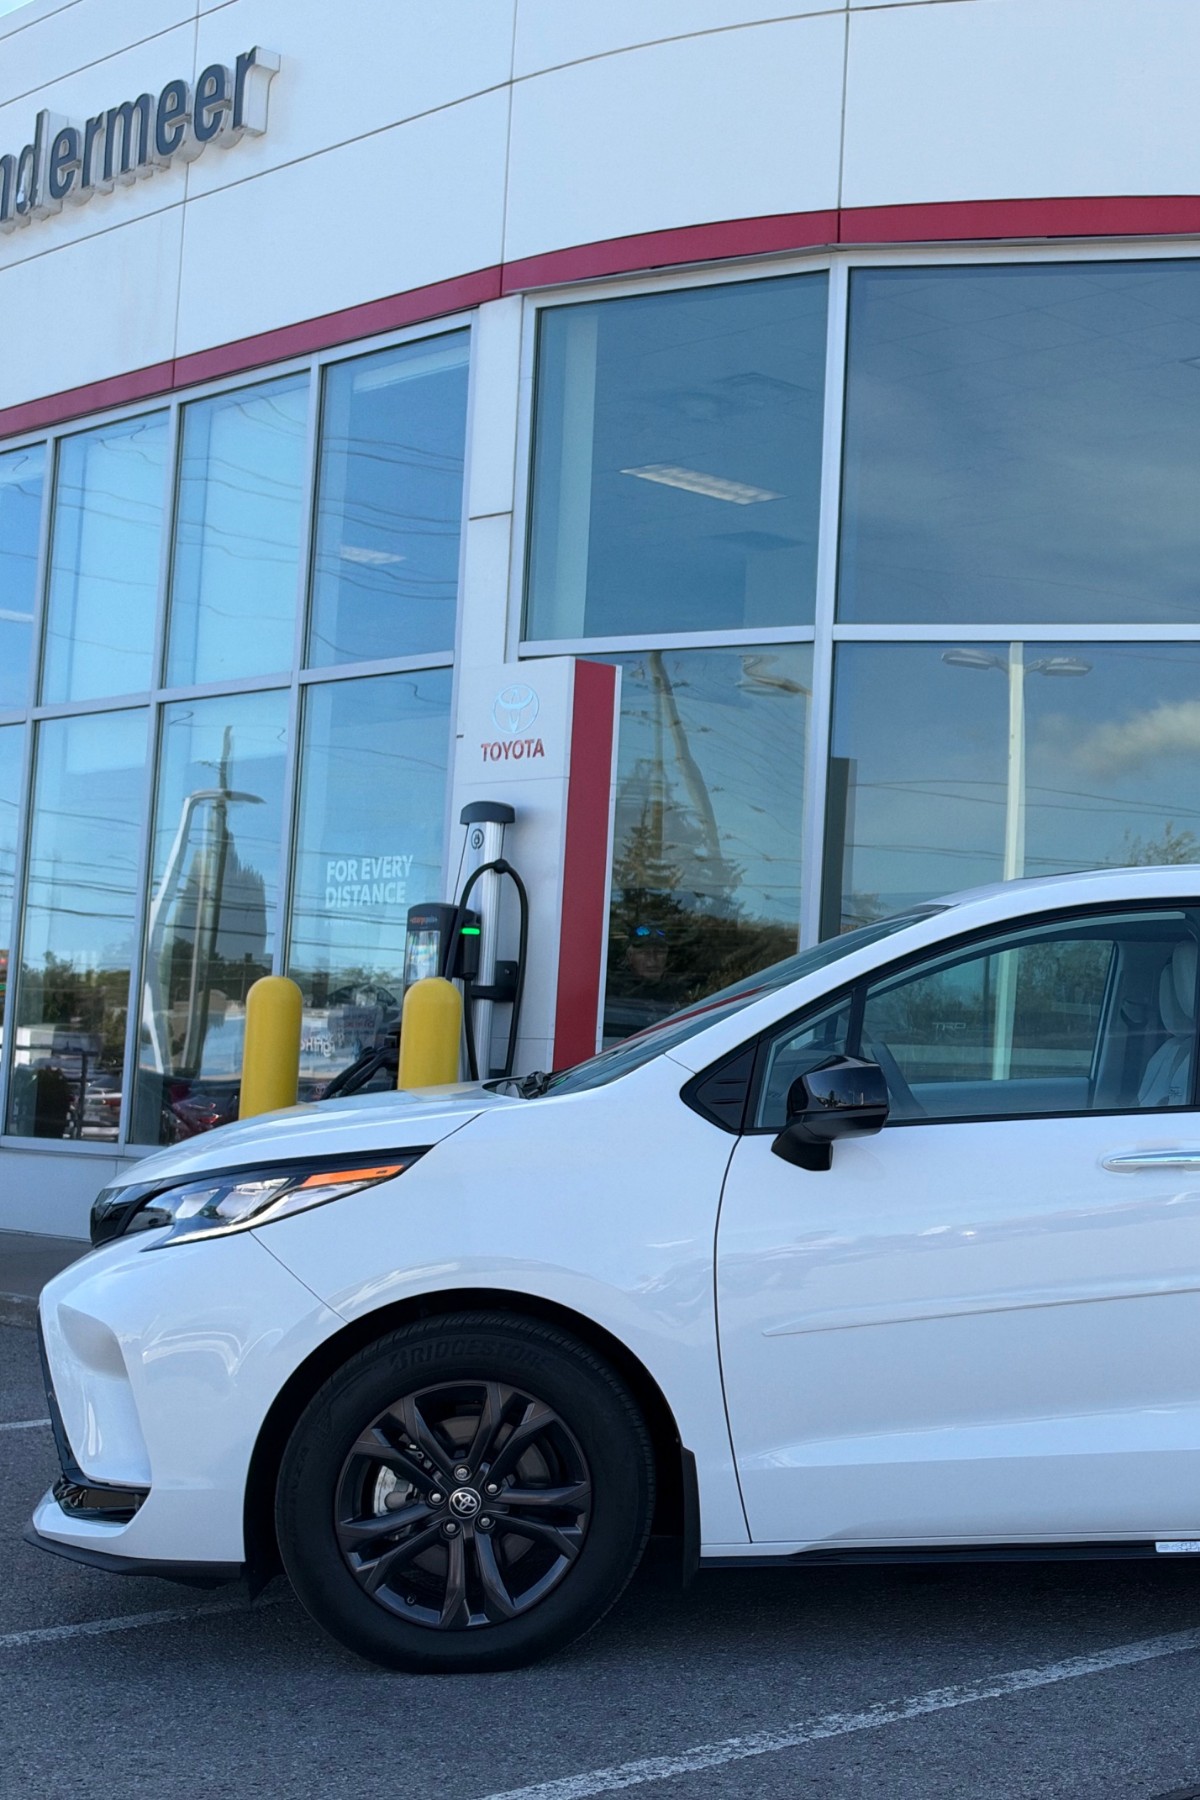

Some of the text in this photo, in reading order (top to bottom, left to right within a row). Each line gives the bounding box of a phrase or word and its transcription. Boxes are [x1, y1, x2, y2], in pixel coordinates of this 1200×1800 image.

[481, 738, 545, 762] TOYOTA
[327, 853, 414, 884] FOR EVERY
[325, 881, 407, 909] DISTANCE
